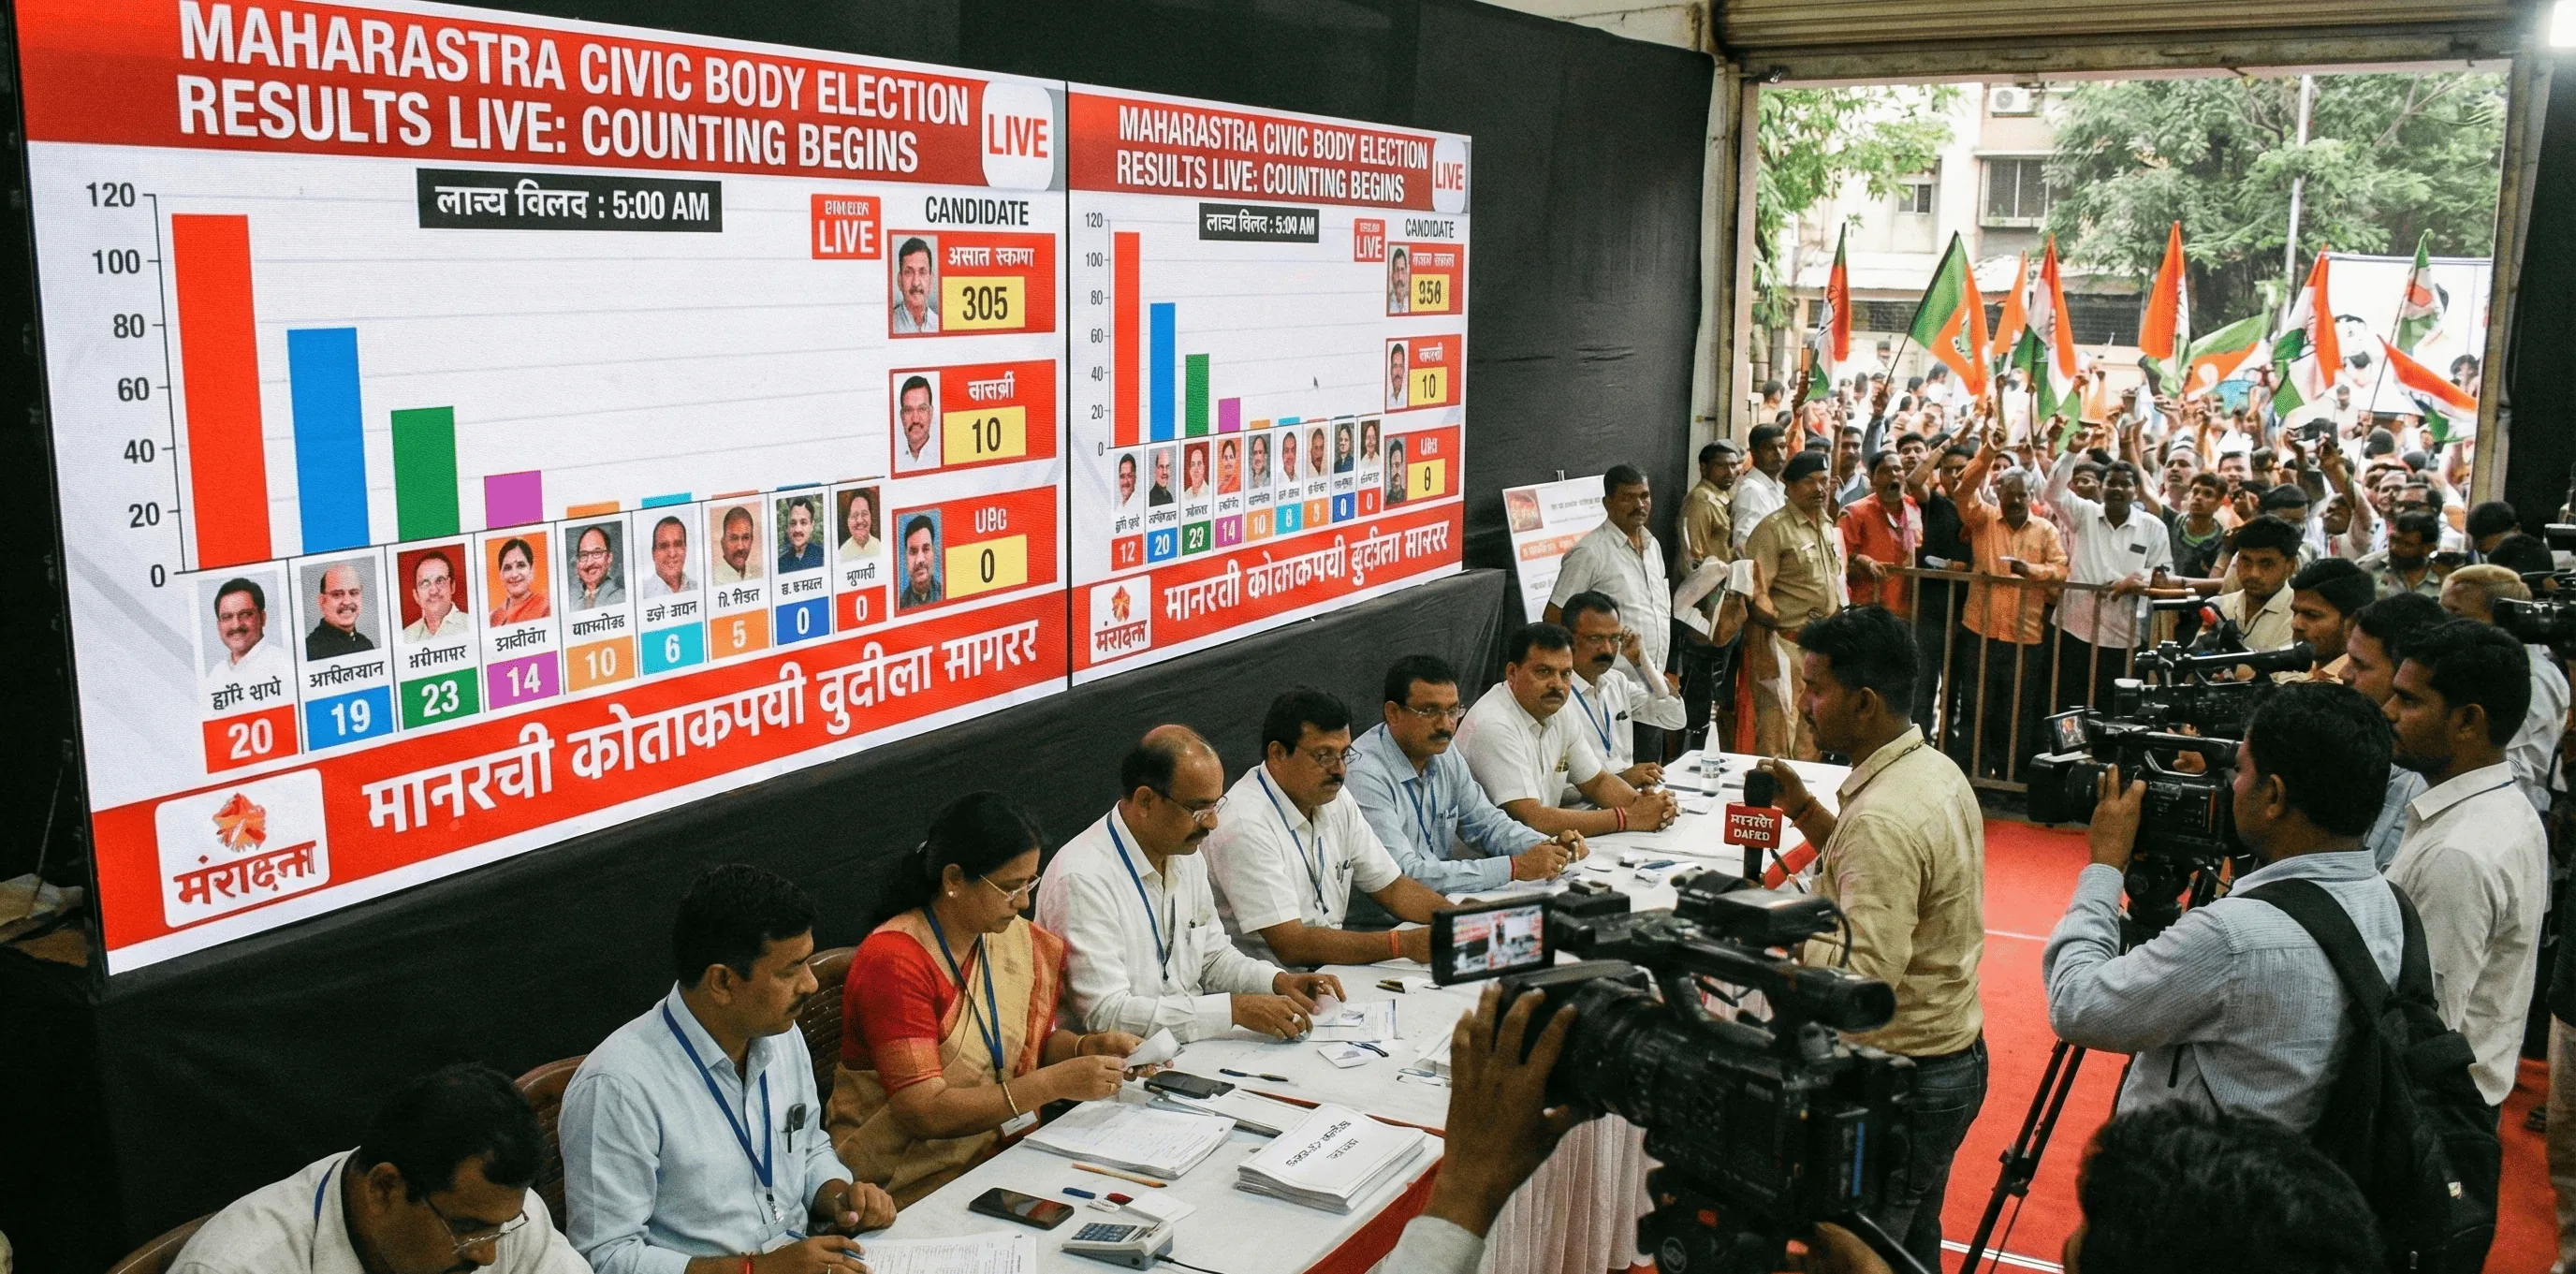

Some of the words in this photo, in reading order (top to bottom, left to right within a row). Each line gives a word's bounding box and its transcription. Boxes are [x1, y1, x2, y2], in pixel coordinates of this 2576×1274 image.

[179, 0, 565, 91] MAHARASTRA
[579, 43, 692, 101] CIVIC
[705, 56, 806, 111] BODY
[817, 69, 969, 127] ELECTION
[176, 74, 432, 147] RESULTS
[448, 95, 566, 154] LIVE:
[581, 104, 787, 167] COUNTING
[798, 122, 918, 173] BEGINS
[988, 112, 1048, 159] LIVE
[1119, 105, 1258, 154] MAHARASTRA
[1264, 123, 1308, 158] CIVIC
[1312, 128, 1355, 164] BODY
[1360, 134, 1428, 170] ELECTION
[1117, 149, 1208, 189] RESULTS
[1212, 157, 1258, 193] LIVE:
[1264, 163, 1347, 199] COUNTING
[1351, 169, 1404, 203] BEGINS
[1434, 159, 1464, 191] LIVE
[85, 182, 136, 209] 120
[611, 189, 666, 220] 5:00
[671, 191, 710, 221] AM
[925, 195, 1030, 227] CANDIDATE
[1085, 212, 1104, 228] 120
[819, 218, 875, 255] LIVE
[1298, 216, 1315, 235] AM
[1405, 218, 1455, 239] CANDIDATE
[1085, 251, 1104, 268] 100
[1356, 235, 1383, 259] LIVE
[92, 248, 141, 275] 100
[962, 286, 1008, 322] 305
[1090, 289, 1104, 305] 80
[112, 313, 145, 339] 80
[1090, 328, 1104, 344] 60
[1090, 365, 1104, 382] 40
[1423, 373, 1436, 399] 10
[117, 376, 150, 403] 60
[1090, 403, 1104, 420] 20
[971, 416, 1002, 454] 10
[124, 438, 155, 464] 40
[1097, 441, 1104, 457] 0
[128, 501, 161, 528] 20
[1253, 514, 1266, 534] 10
[1154, 533, 1170, 557] 20
[1222, 520, 1237, 543] 14
[980, 548, 996, 583] 0
[1119, 540, 1135, 564] 12
[150, 564, 166, 588] 0
[796, 607, 810, 635] 0
[855, 594, 868, 622] 0
[732, 619, 747, 649] 5
[665, 633, 681, 664] 6
[584, 646, 618, 681] 10
[505, 662, 542, 697] 14
[421, 680, 461, 718] 23
[330, 698, 372, 737] 19
[227, 717, 274, 760] 20
